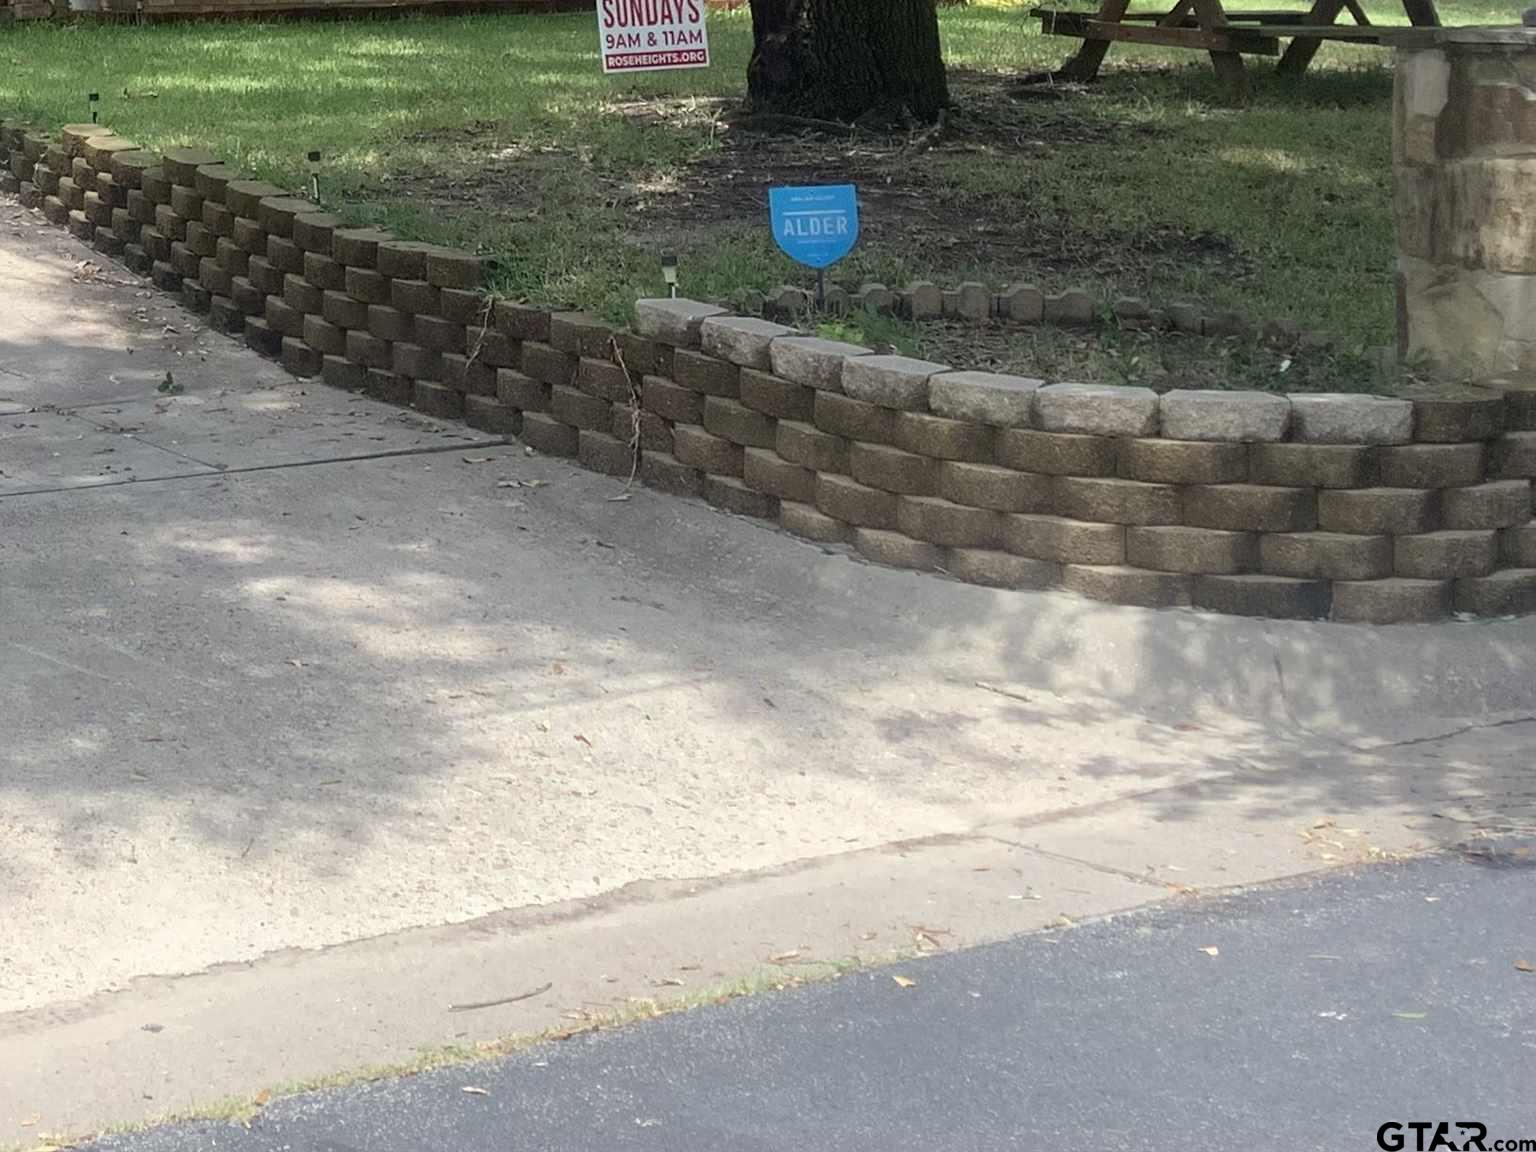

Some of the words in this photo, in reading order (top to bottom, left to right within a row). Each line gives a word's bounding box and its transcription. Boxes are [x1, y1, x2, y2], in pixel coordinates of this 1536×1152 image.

[605, 32, 641, 49] 9AM
[647, 31, 657, 47] &
[662, 29, 703, 46] 11AM
[607, 51, 705, 67] ROSEHEIGHTS.ORG
[783, 216, 848, 236] ALDER
